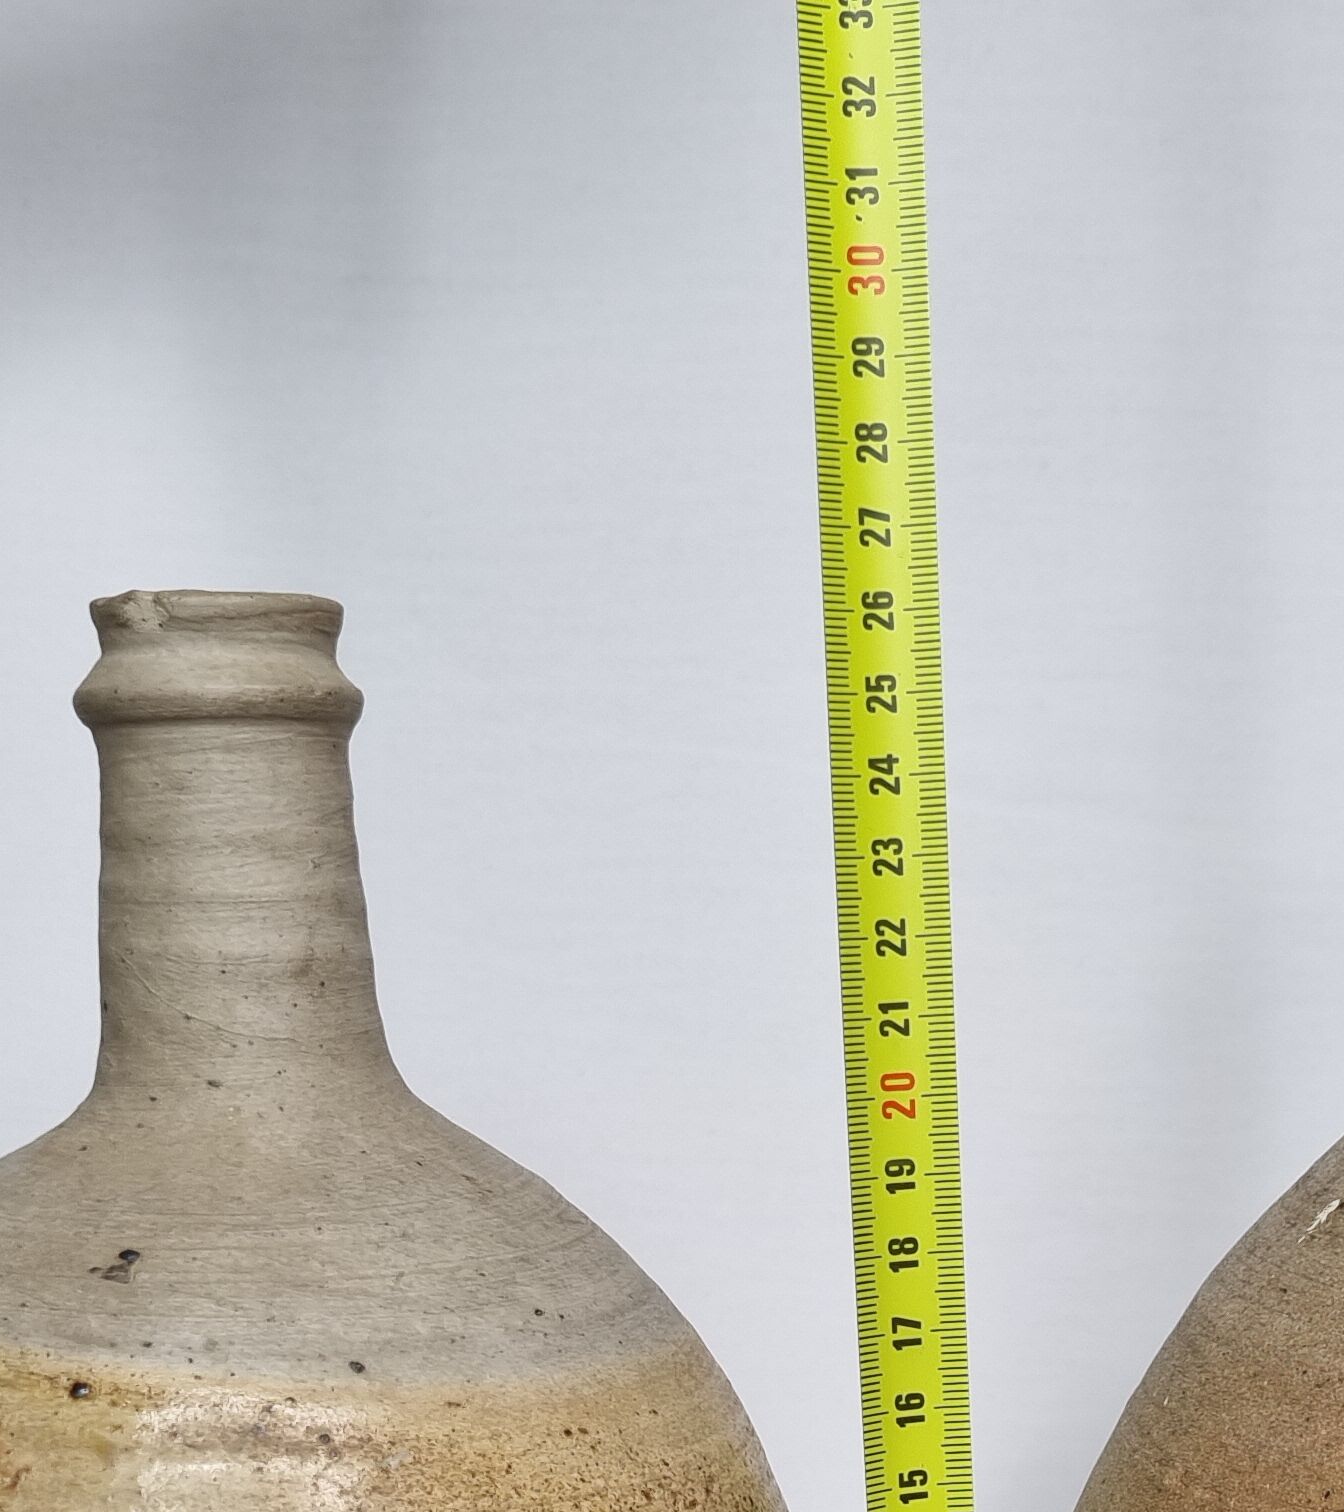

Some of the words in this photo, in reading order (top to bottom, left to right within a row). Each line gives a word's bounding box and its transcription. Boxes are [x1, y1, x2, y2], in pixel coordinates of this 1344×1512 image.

[842, 76, 876, 118] 32
[844, 168, 879, 205] 31
[847, 245, 885, 295] 30
[852, 338, 885, 378] 29
[854, 423, 888, 463] 28
[857, 507, 891, 547] 27
[860, 591, 894, 631] 26
[862, 674, 897, 714] 25
[866, 753, 901, 796] 24
[870, 837, 904, 877] 23
[872, 918, 907, 957] 22
[876, 1001, 910, 1038] 21
[879, 1072, 916, 1120] 20
[883, 1158, 916, 1196] 19
[886, 1236, 919, 1274] 18
[889, 1315, 923, 1353] 17
[893, 1392, 926, 1429] 16
[897, 1469, 929, 1506] 15
